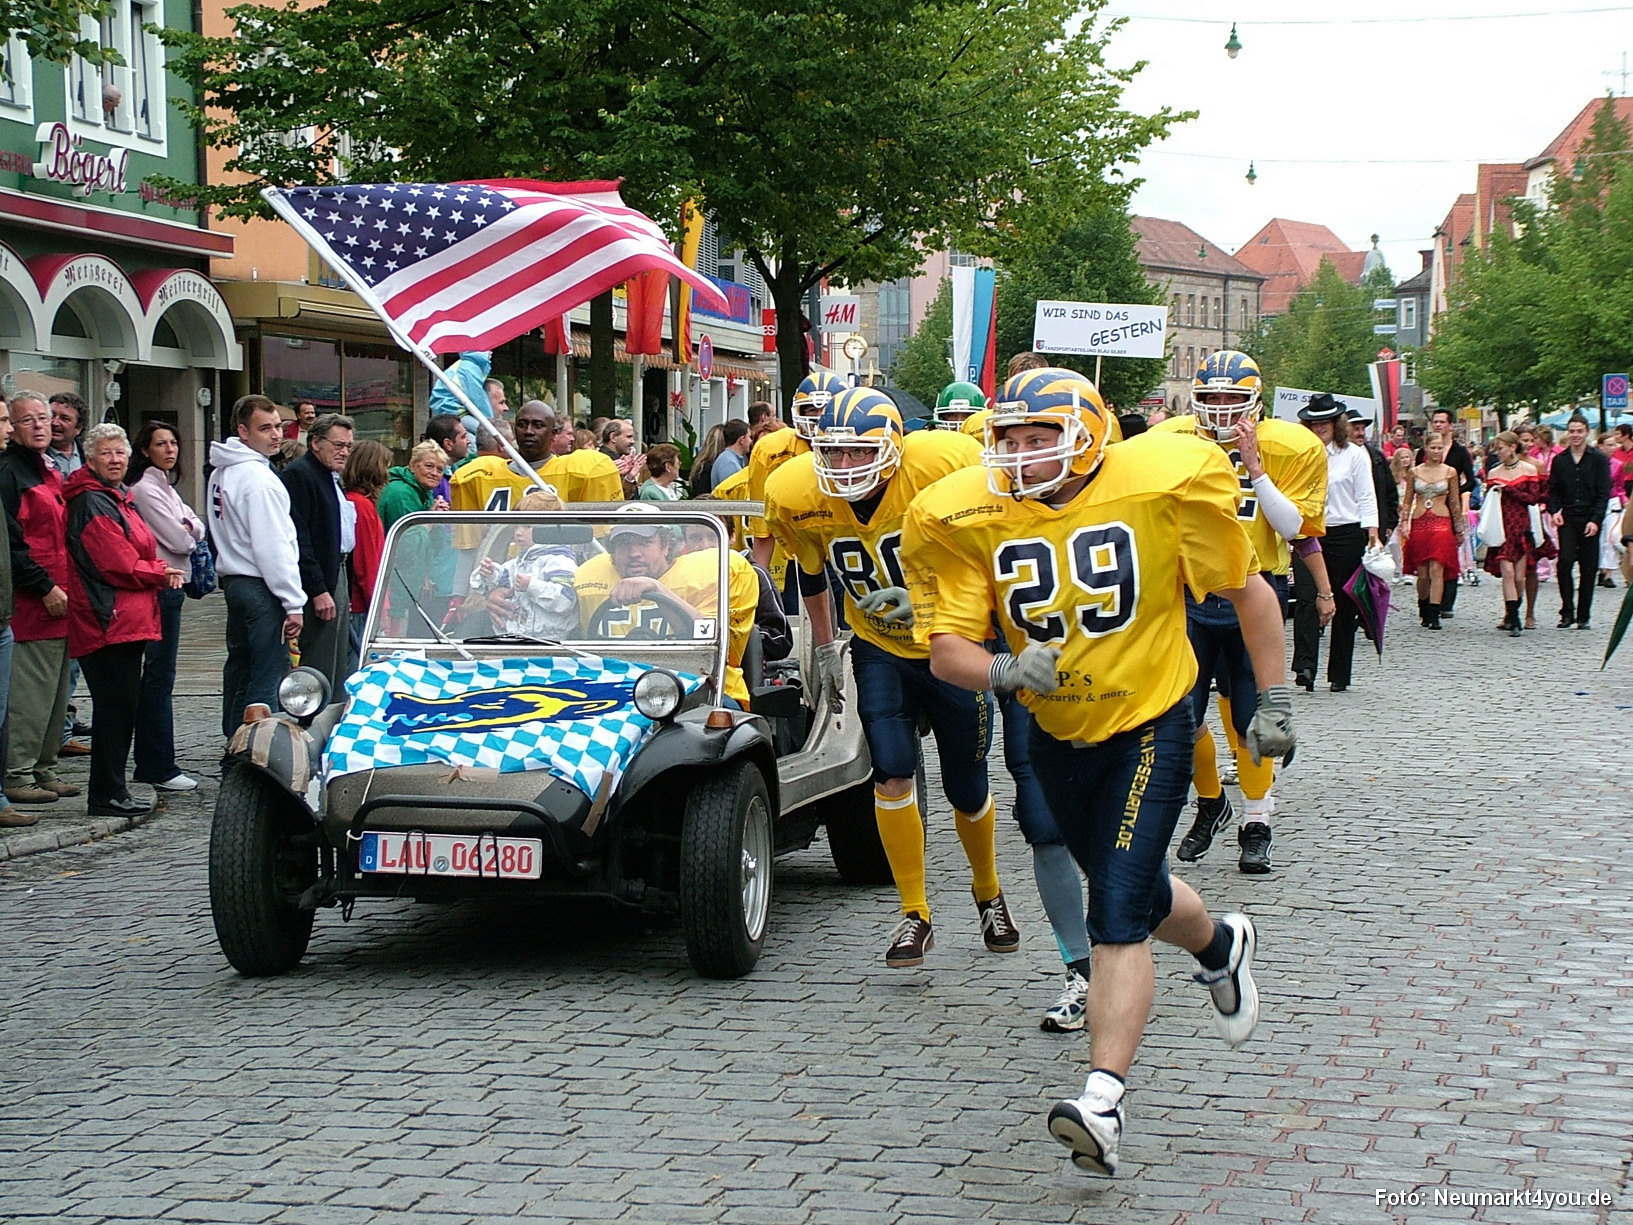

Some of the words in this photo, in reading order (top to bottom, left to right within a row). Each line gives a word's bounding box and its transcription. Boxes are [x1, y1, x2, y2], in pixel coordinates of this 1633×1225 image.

[47, 122, 129, 196] Bögerl
[64, 262, 124, 295] Metzgerei
[825, 303, 856, 325] H&M
[1042, 307, 1067, 318] WIR
[1071, 309, 1100, 320] SIND
[1105, 311, 1129, 321] DAS
[1090, 318, 1163, 347] GESTERN
[1279, 391, 1299, 401] WIR
[1606, 397, 1628, 406] TAXI
[993, 520, 1140, 644] 29
[1085, 691, 1096, 703] &
[365, 855, 373, 865] D
[381, 839, 432, 869] LAU
[452, 842, 533, 874] 06280
